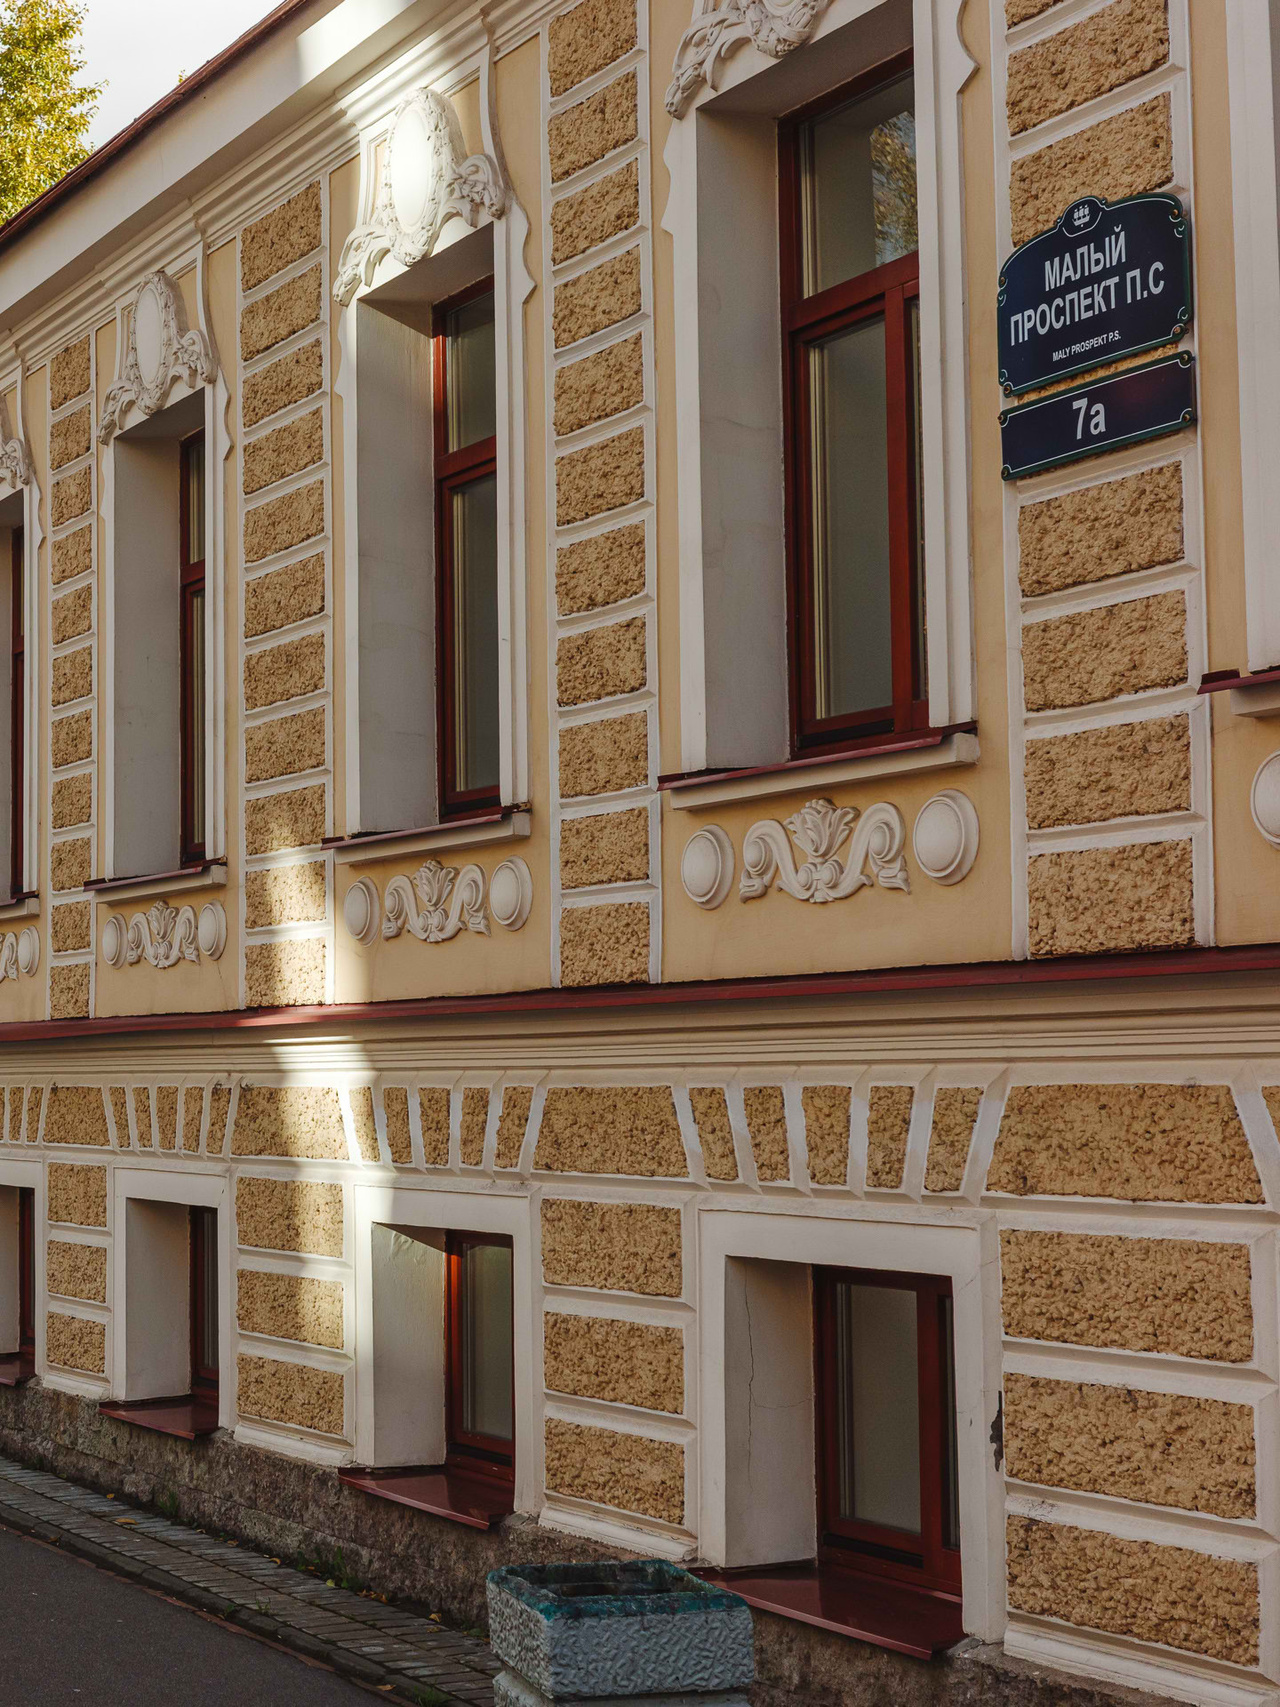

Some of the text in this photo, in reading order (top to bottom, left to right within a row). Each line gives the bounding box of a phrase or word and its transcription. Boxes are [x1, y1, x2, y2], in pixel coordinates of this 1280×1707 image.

[1044, 224, 1127, 292] МАЛЫЙ
[1010, 260, 1165, 347] ПРОСПЕКТ П.С
[1052, 331, 1122, 362] MALY PROSPEKT P.S.
[1072, 397, 1107, 440] 7а
